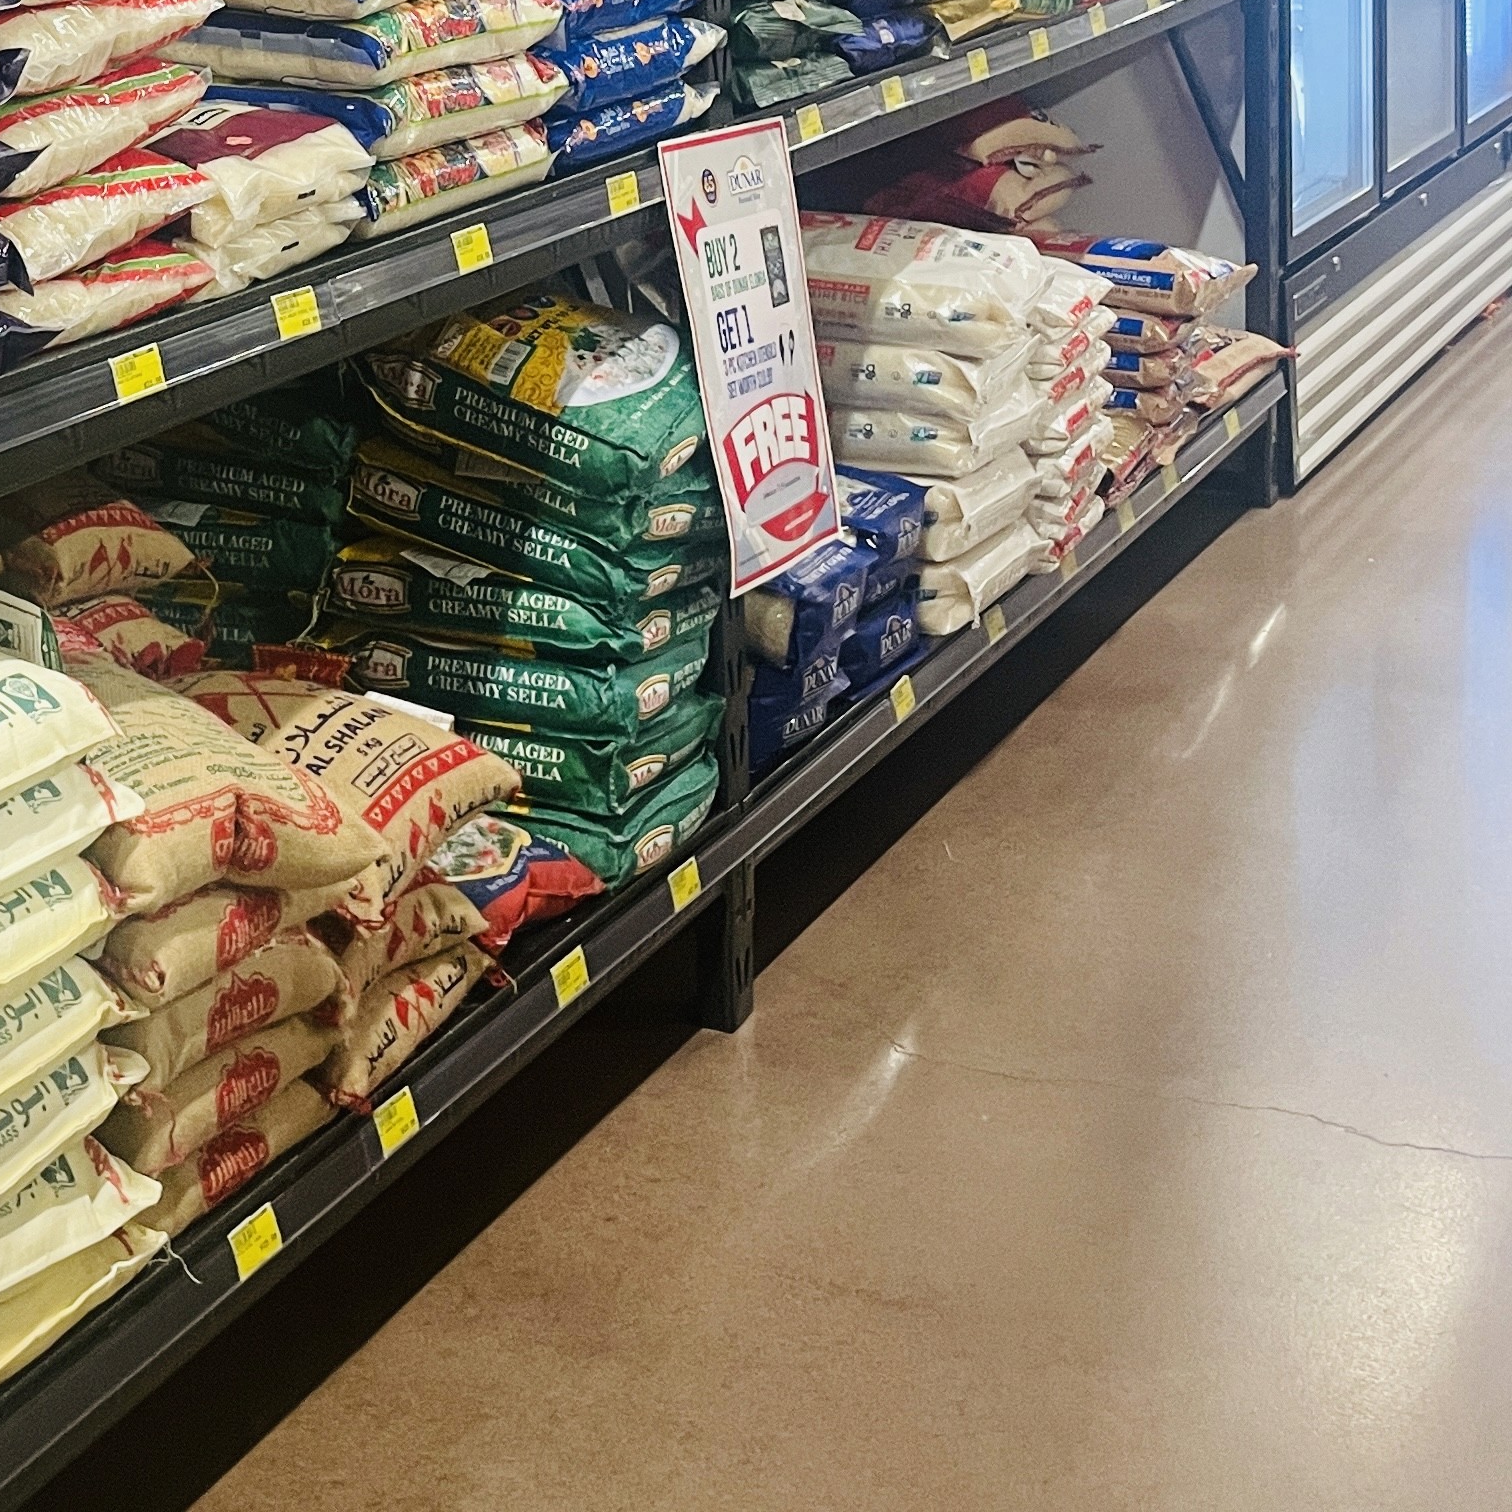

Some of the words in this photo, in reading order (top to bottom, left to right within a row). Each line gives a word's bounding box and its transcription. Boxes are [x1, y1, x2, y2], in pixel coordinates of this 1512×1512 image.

[704, 238, 730, 279] BUY
[729, 234, 741, 272] 2
[716, 307, 741, 354] GET
[453, 404, 523, 443] CREAMY
[528, 436, 581, 468] SELLA
[454, 386, 536, 430] PREMIUM
[539, 421, 589, 451] AGED
[730, 395, 812, 492] FREE
[249, 486, 302, 509] SELLA
[258, 473, 305, 494] AGED
[523, 481, 577, 517] SELLA
[437, 513, 509, 551] CREAMY
[511, 538, 572, 569] SELLA
[439, 495, 522, 535] PREMIUM
[524, 523, 578, 551] AGED
[428, 579, 515, 606] PREMIUM
[517, 591, 571, 612] AGED
[428, 598, 503, 622] CREAMY
[507, 608, 568, 632] SELLA
[427, 654, 516, 684] PREMIUM
[517, 670, 571, 691] AGED
[428, 672, 505, 700] CREAMY
[509, 686, 567, 711] SELLA
[306, 744, 339, 779] AL
[332, 706, 390, 757] SHALAN
[511, 739, 566, 763] AGED
